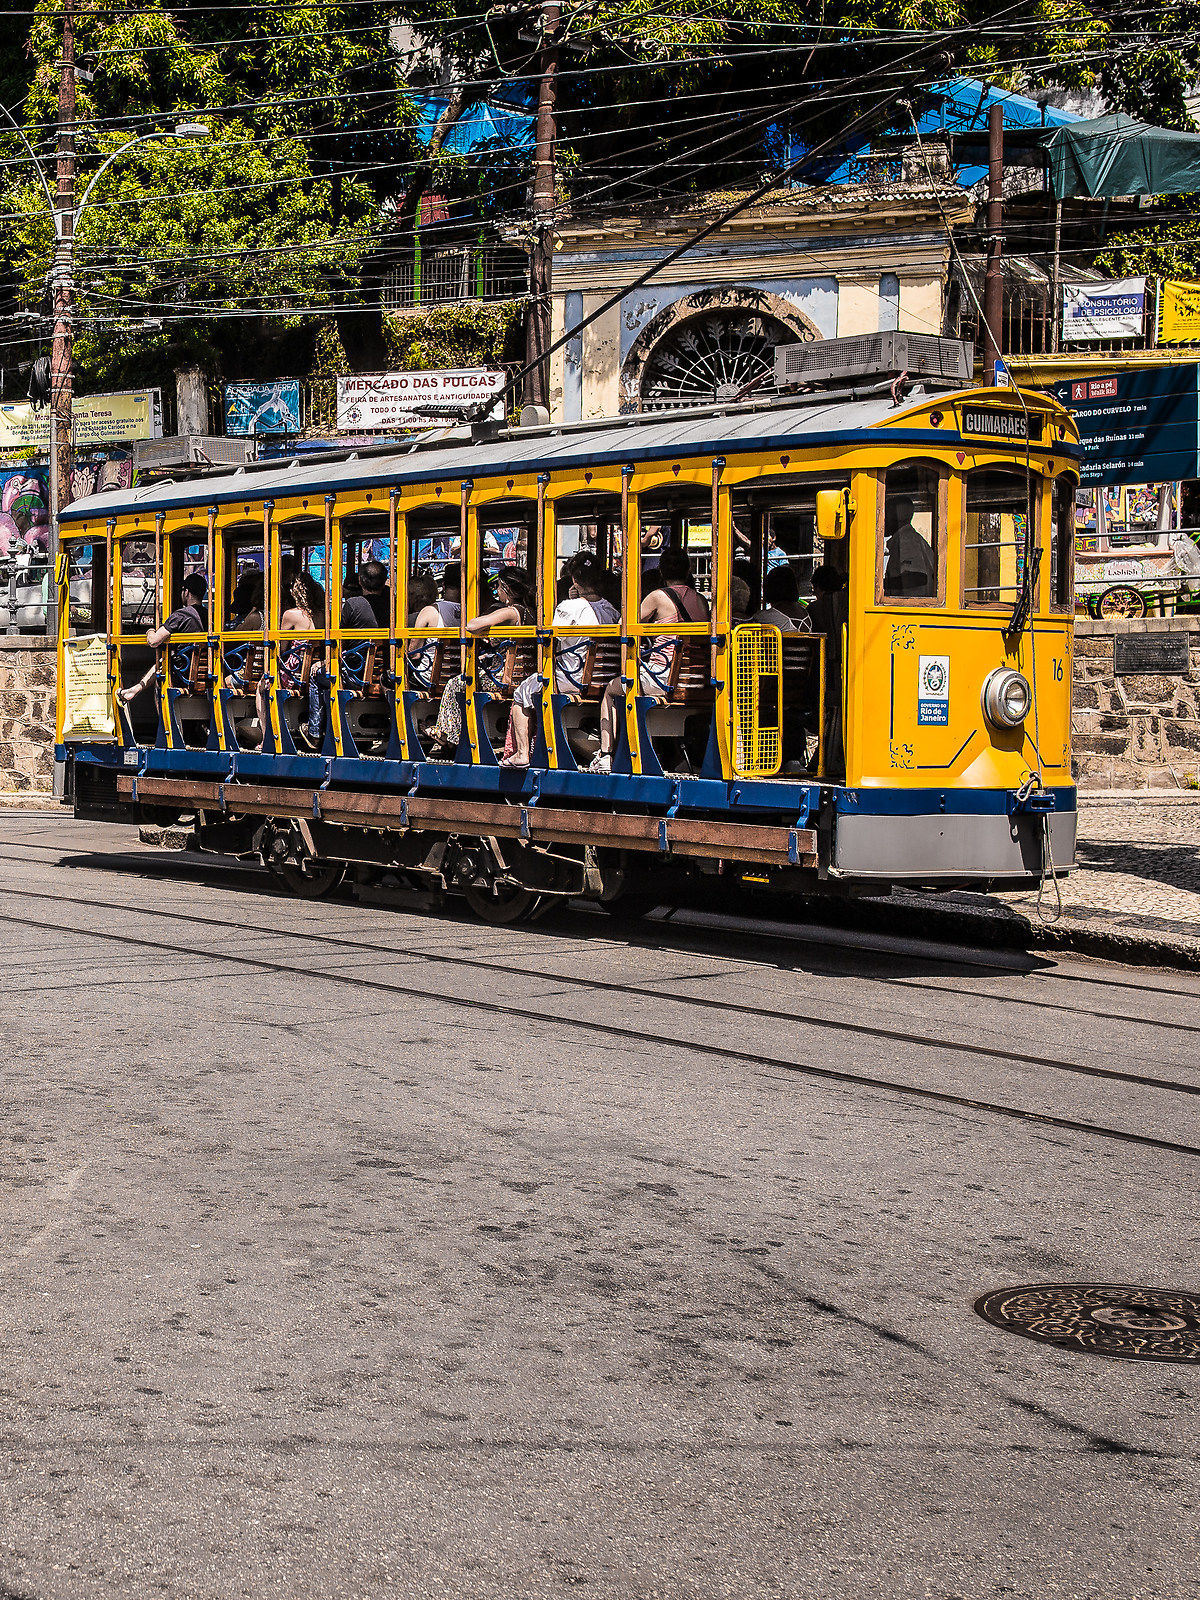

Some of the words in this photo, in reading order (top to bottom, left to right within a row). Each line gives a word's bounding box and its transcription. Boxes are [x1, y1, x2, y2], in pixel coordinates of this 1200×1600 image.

[1080, 297, 1138, 308] CONSULTÓRIO
[1081, 309, 1092, 317] DE
[1094, 307, 1143, 316] PSICOLOGIA
[345, 379, 408, 391] MERCADO
[413, 377, 438, 389] DAS
[443, 376, 496, 388] PULGAS
[380, 394, 431, 402] ARTESANATOS
[440, 392, 490, 400] ANTIGUIDADE
[1103, 405, 1131, 414] CURVELO
[966, 413, 1026, 436] GUIMARÃES
[1102, 460, 1126, 470] Selarón
[1052, 658, 1063, 682] 16
[933, 707, 942, 715] de
[920, 714, 947, 722] Janeiro
